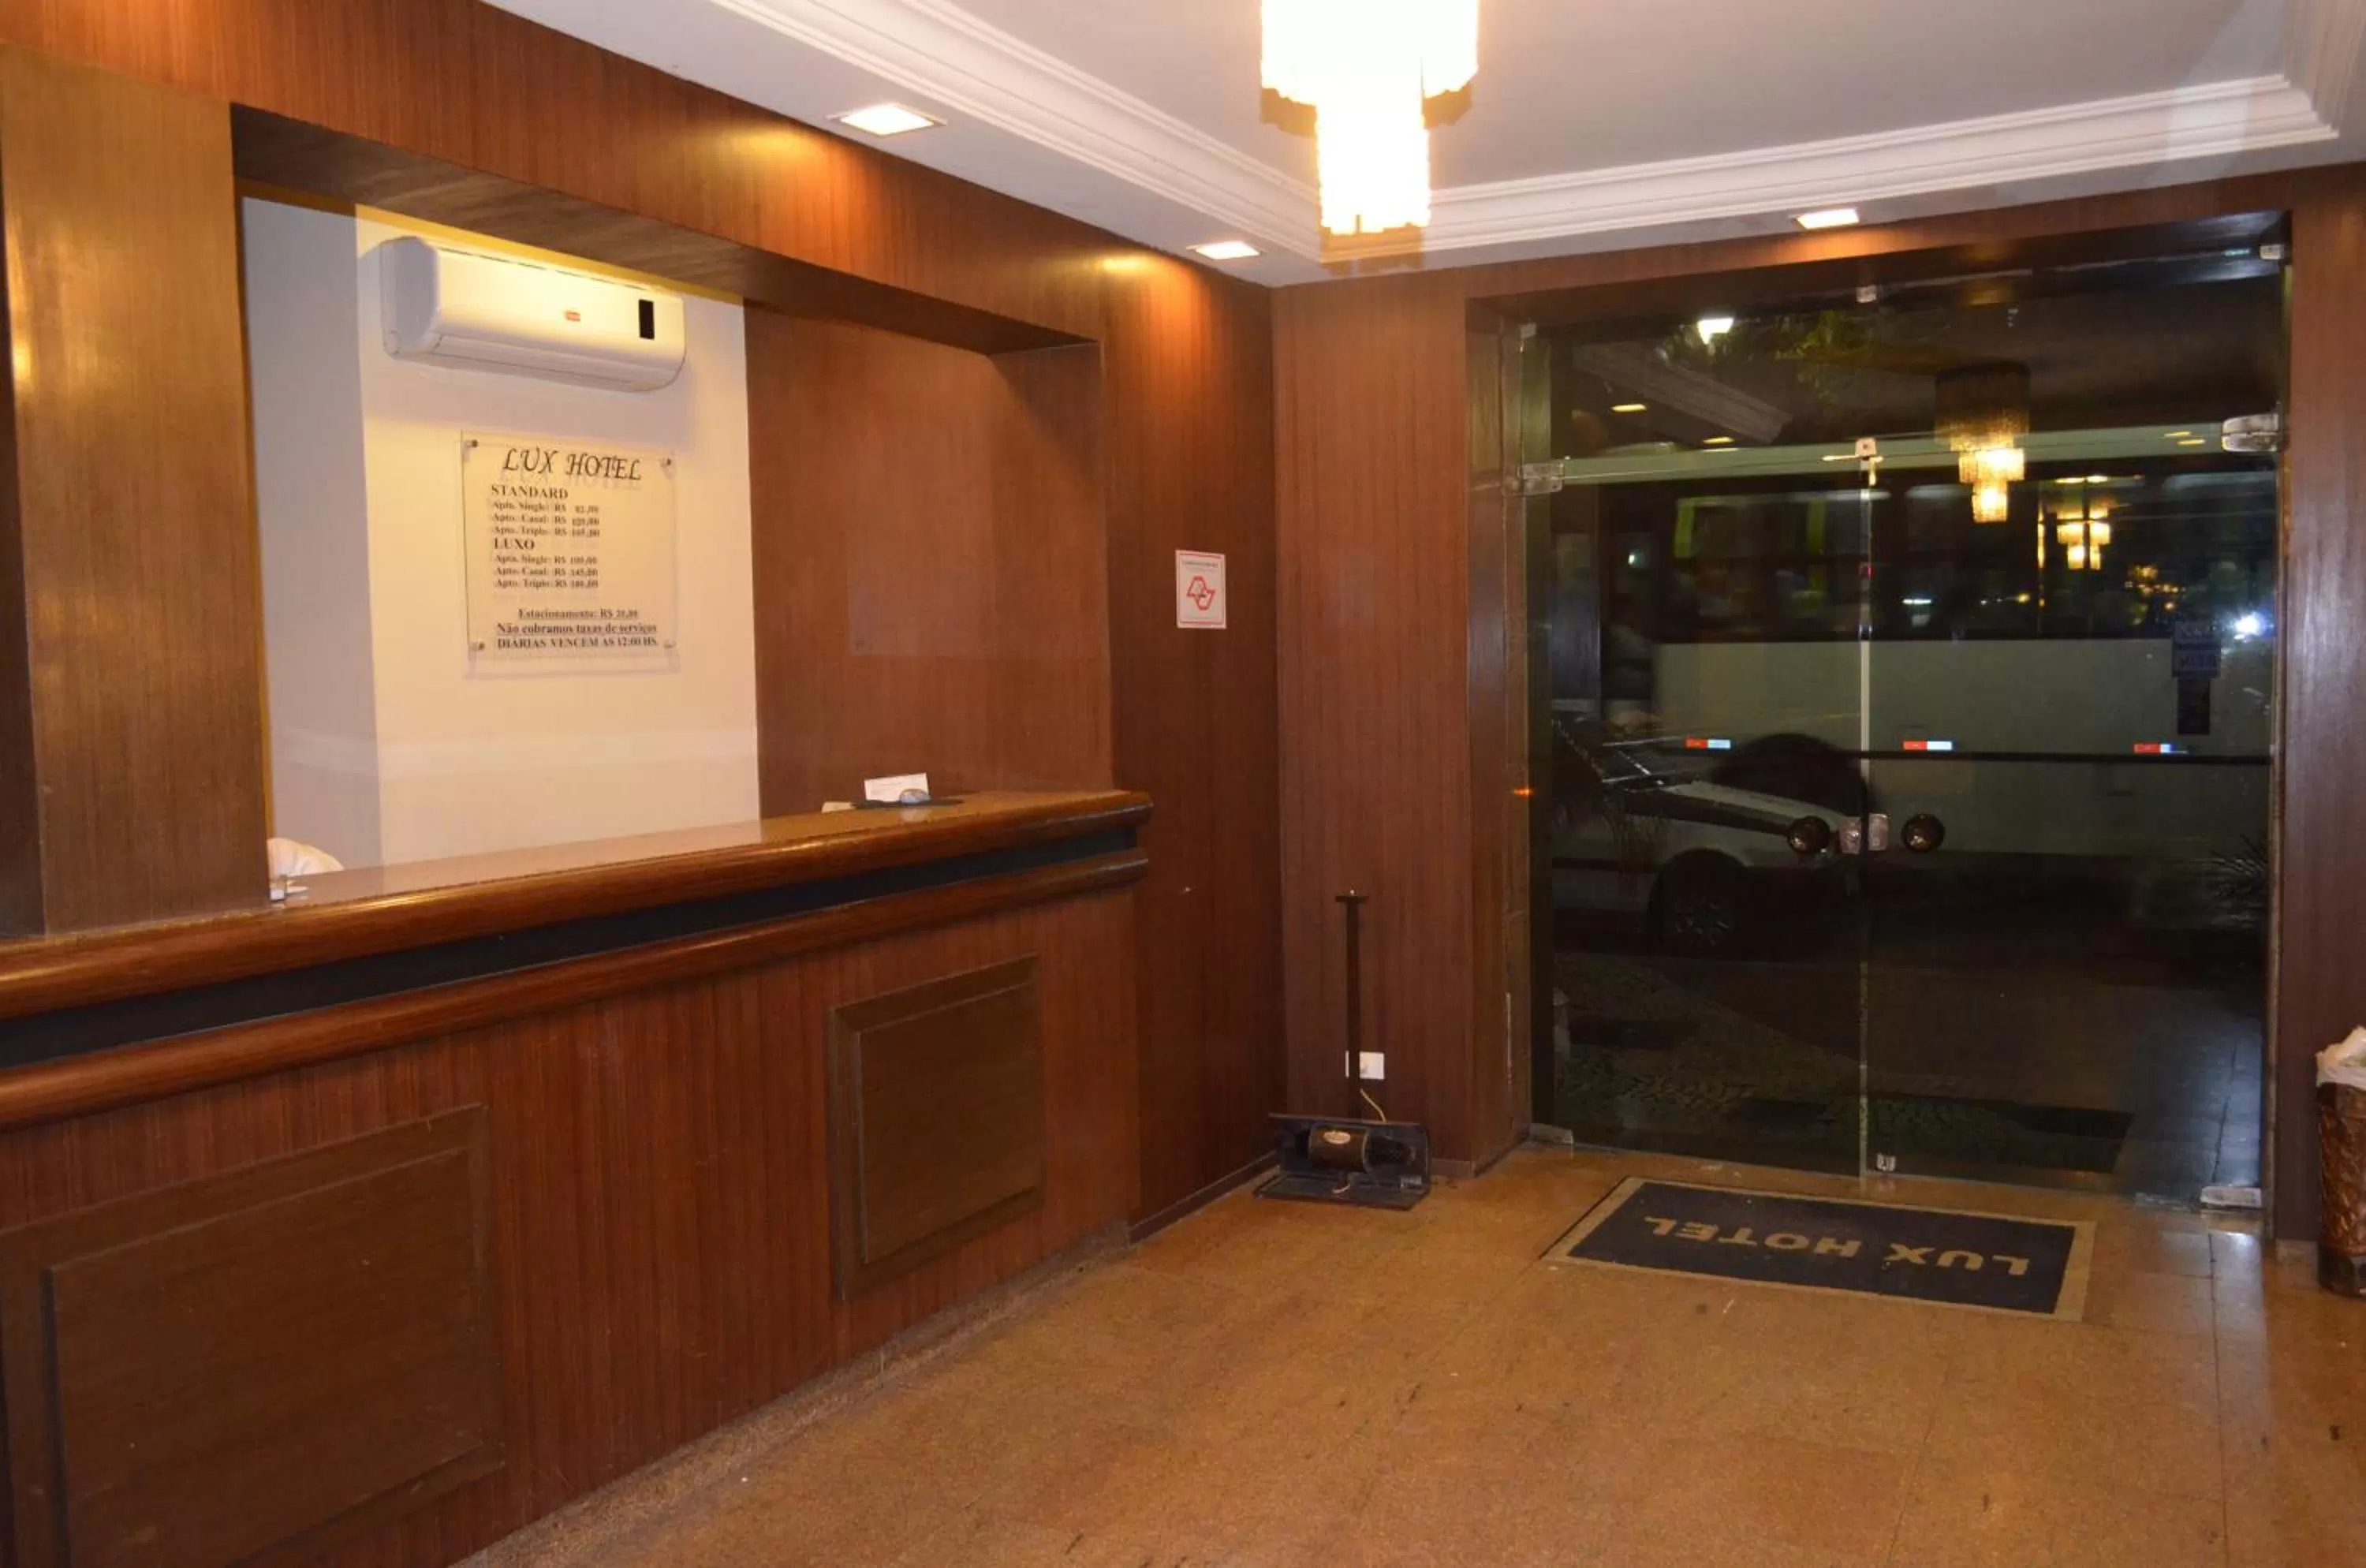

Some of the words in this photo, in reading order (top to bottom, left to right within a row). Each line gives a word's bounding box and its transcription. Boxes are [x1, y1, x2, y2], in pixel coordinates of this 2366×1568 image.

[502, 447, 559, 474] LUX
[565, 452, 643, 480] HOTEL
[491, 484, 569, 499] STANDARD
[494, 537, 535, 550] LUXO
[550, 637, 599, 648] VENCEM
[1644, 1216, 1862, 1257] HOTEL
[1884, 1243, 2029, 1275] LUX
